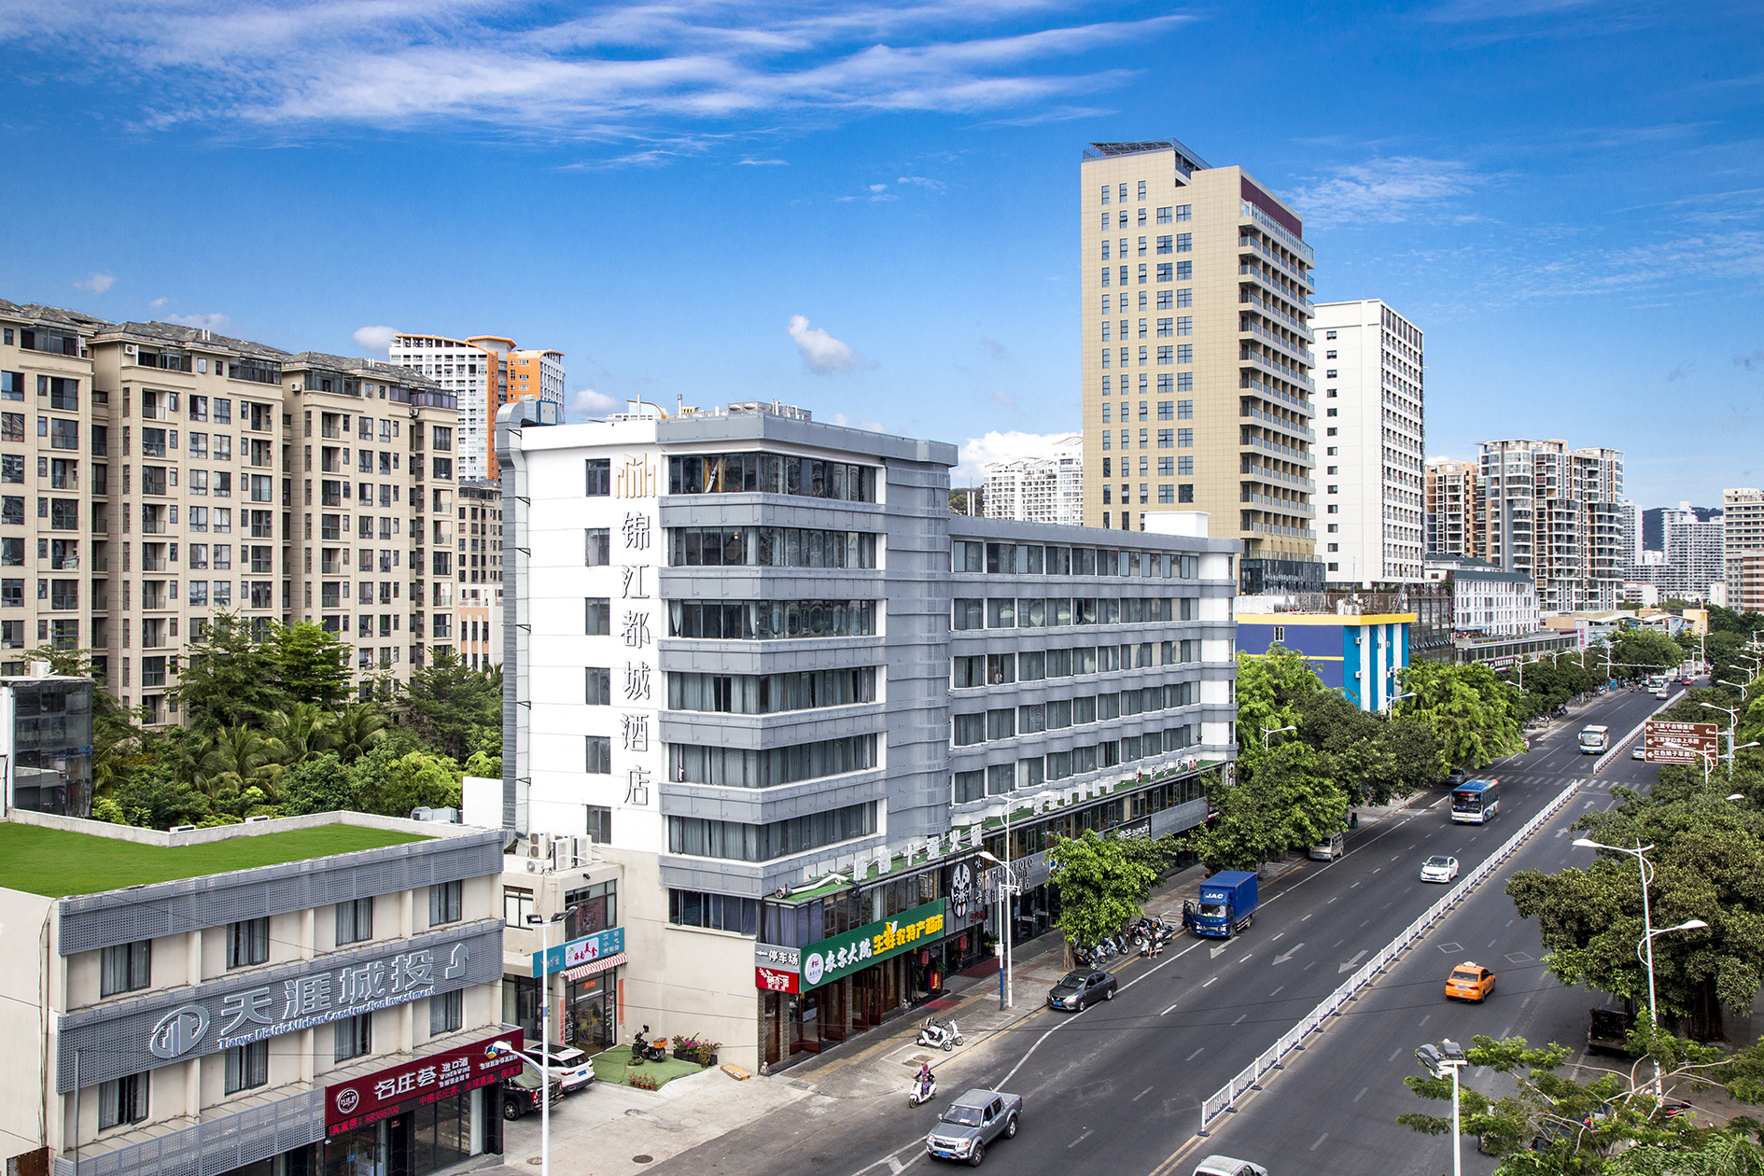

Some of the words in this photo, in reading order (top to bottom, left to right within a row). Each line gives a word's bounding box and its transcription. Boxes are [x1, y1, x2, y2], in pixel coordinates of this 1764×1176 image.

[620, 511, 651, 806] 锦江都城酒店
[873, 914, 944, 956] 生鲜农特产超市
[768, 949, 799, 966] 停车场
[220, 949, 434, 1036] 天涯城投
[374, 1065, 437, 1101] 名庄荟
[441, 1056, 469, 1073] 进口酒
